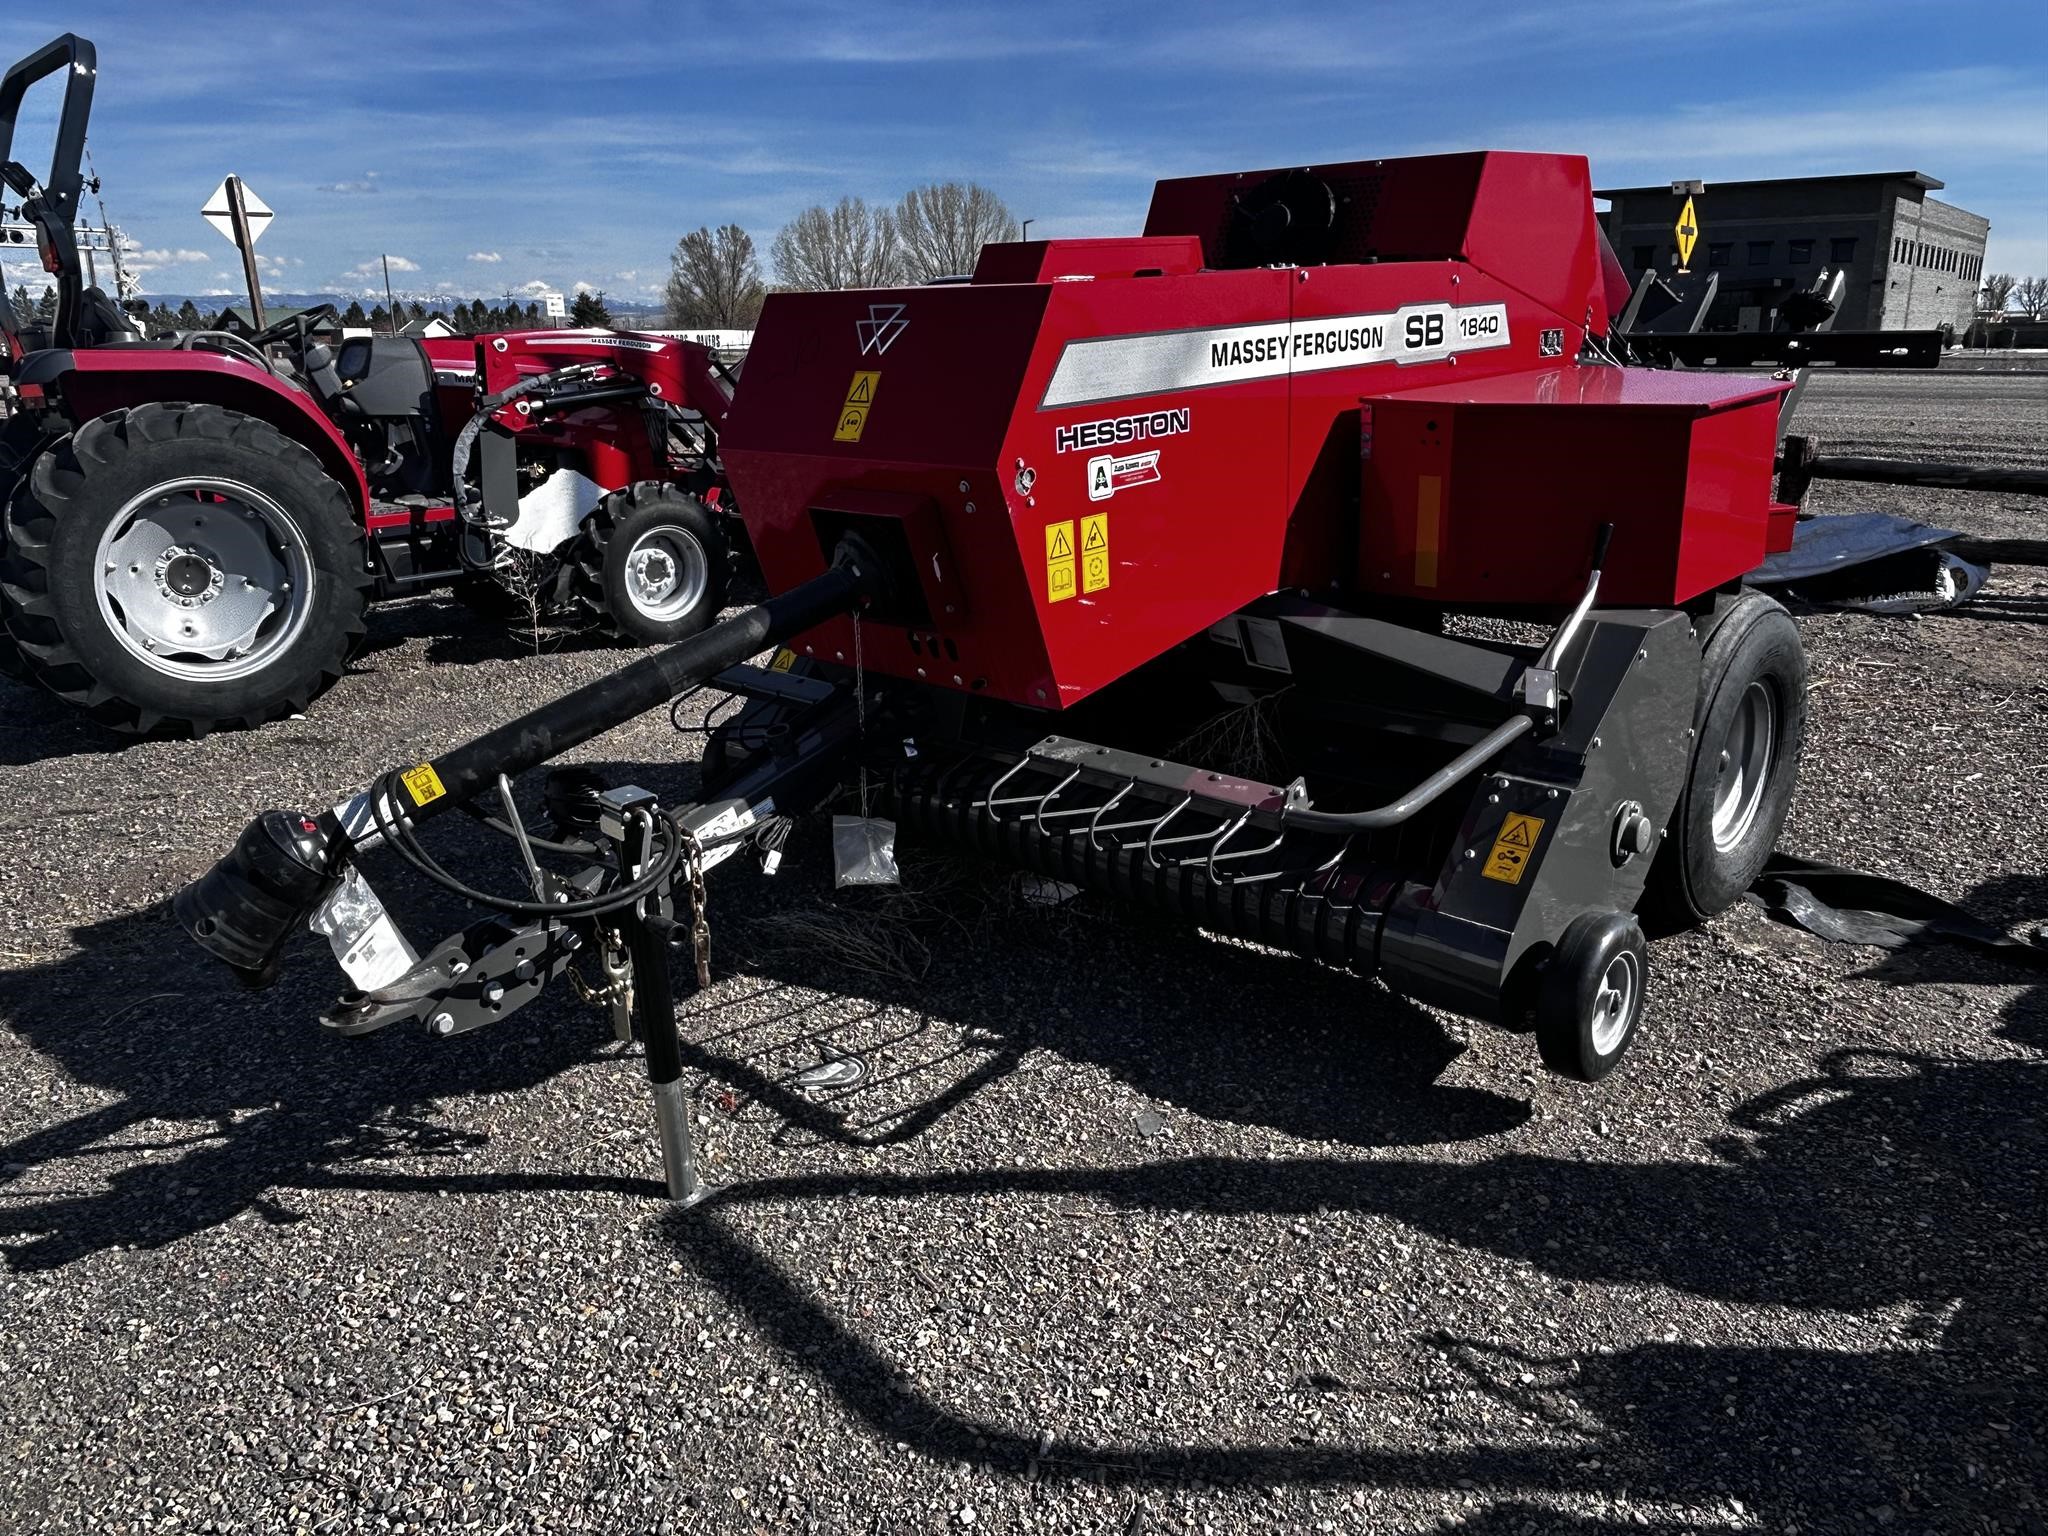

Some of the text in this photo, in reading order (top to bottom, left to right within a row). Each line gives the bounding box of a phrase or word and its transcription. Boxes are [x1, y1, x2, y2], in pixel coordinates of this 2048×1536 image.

[1211, 313, 1498, 368] MASSEY FERGUSON SB 1840
[1057, 409, 1189, 452] HESSTON
